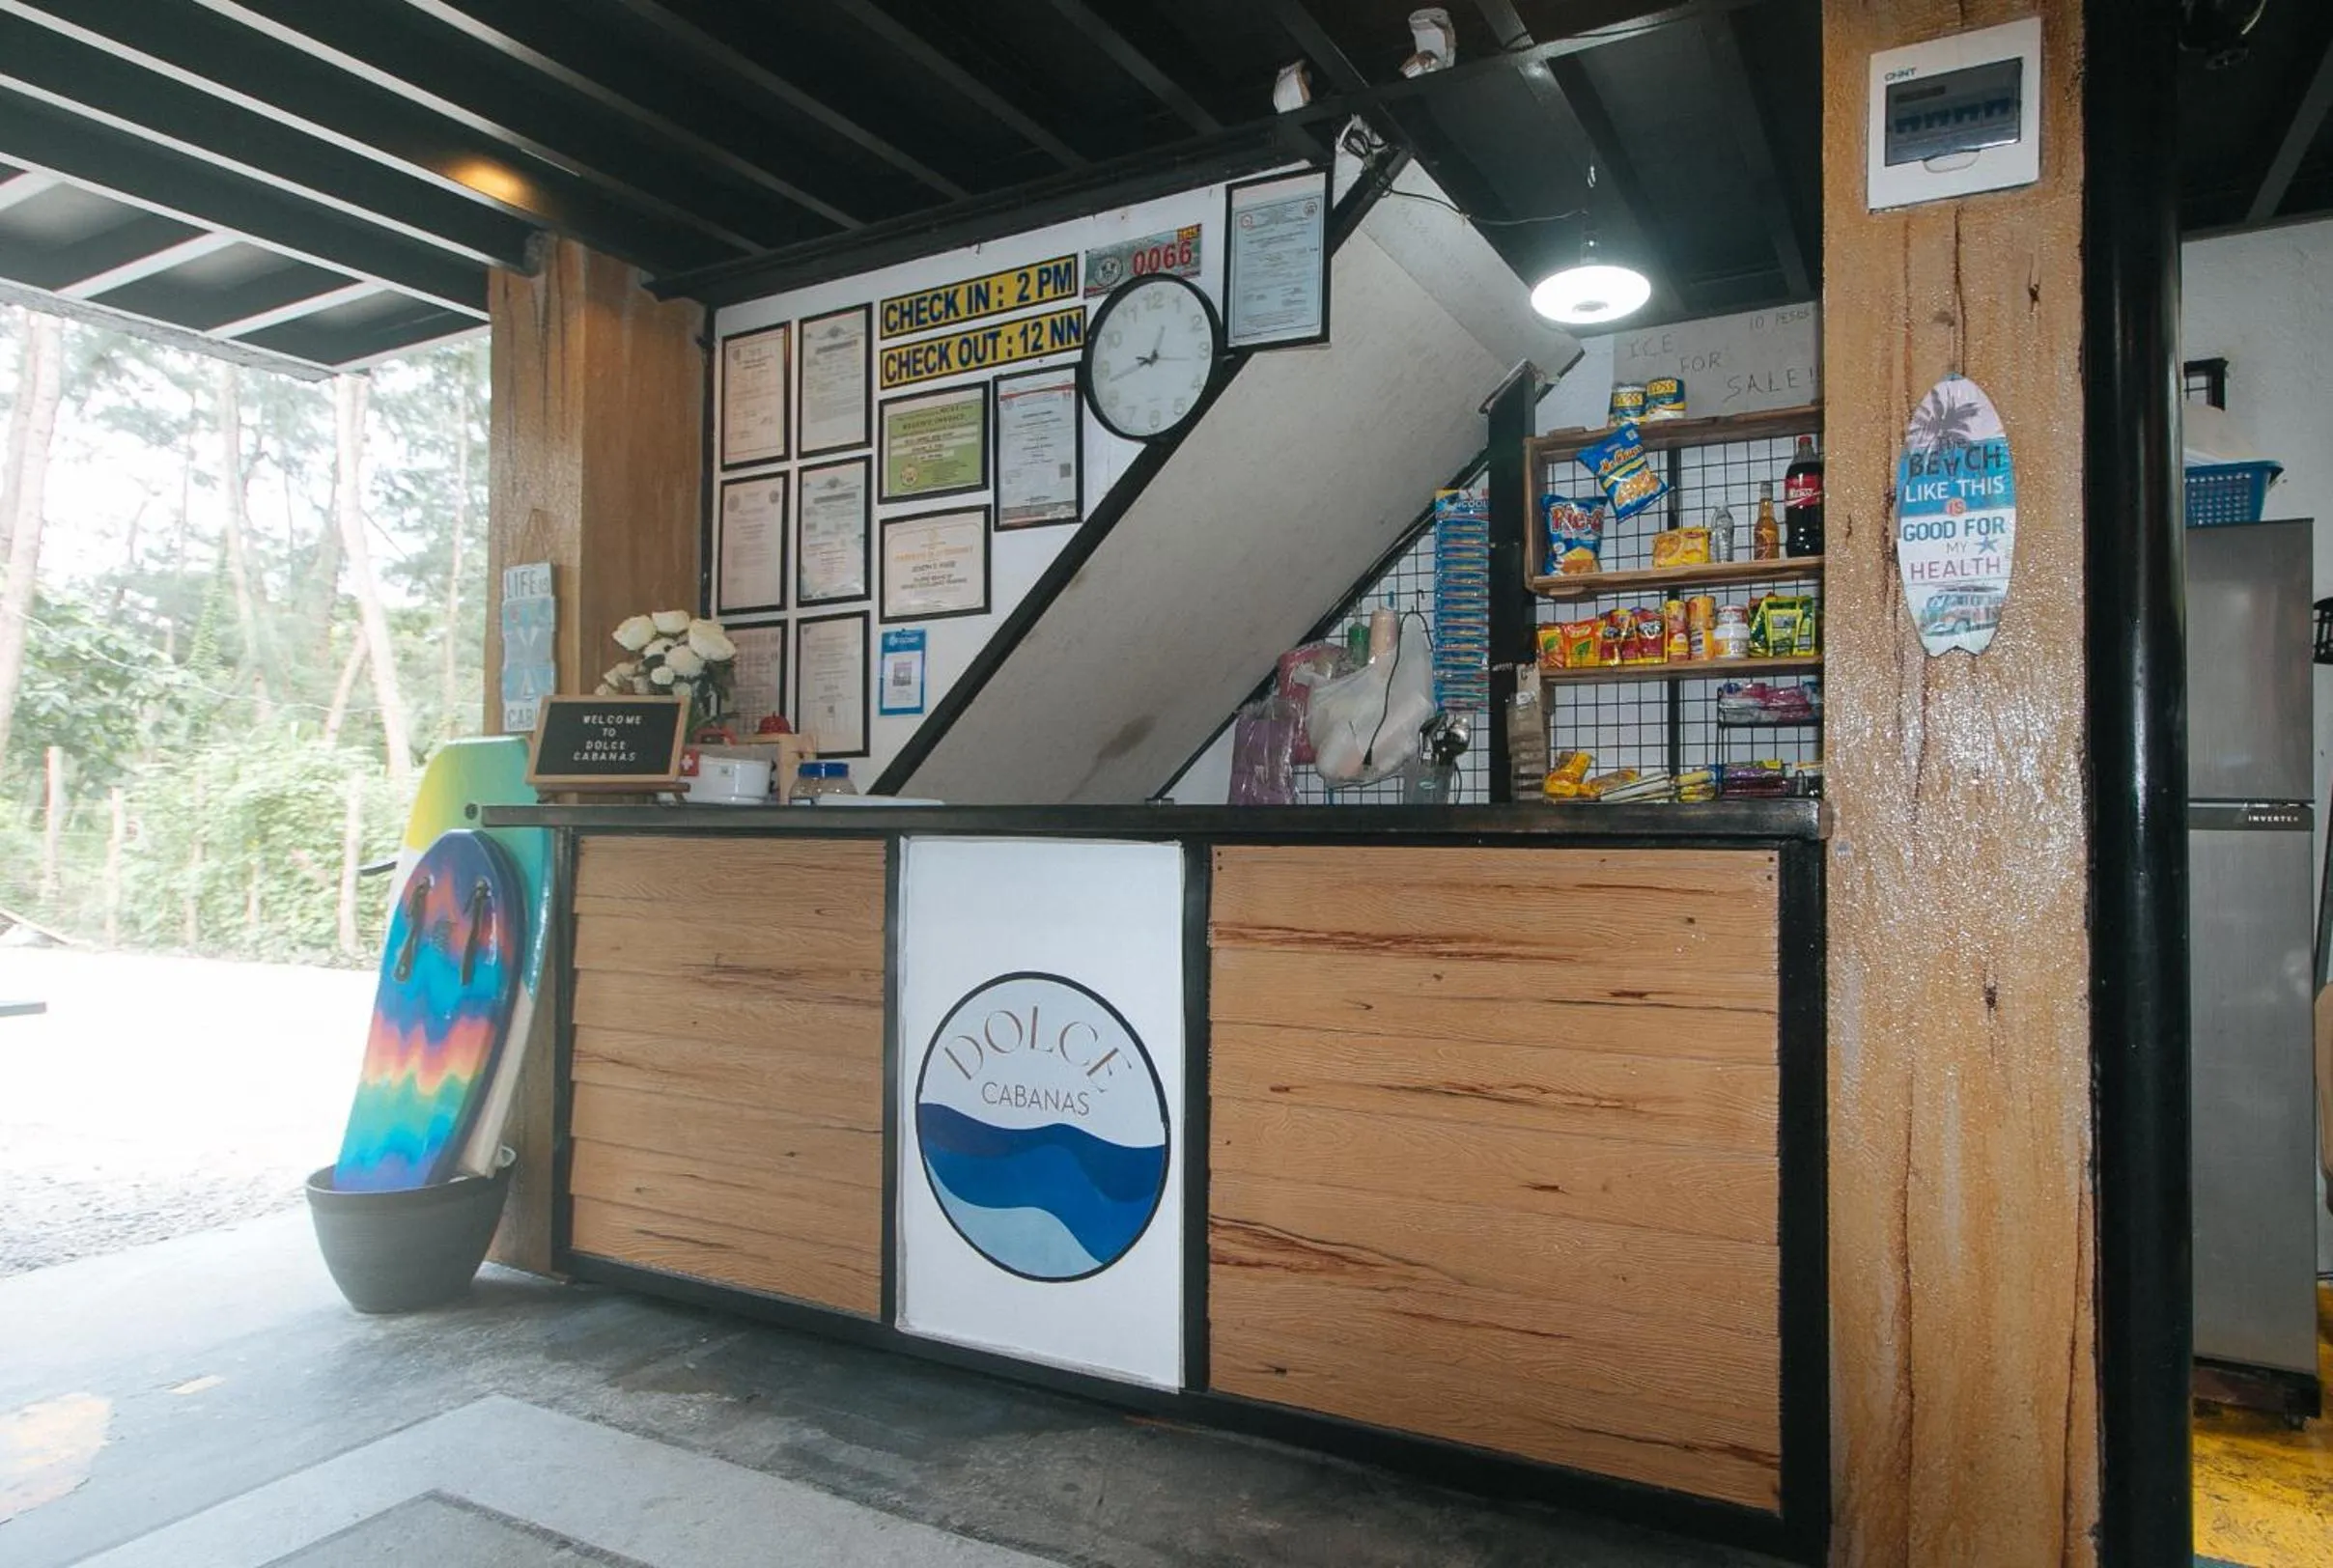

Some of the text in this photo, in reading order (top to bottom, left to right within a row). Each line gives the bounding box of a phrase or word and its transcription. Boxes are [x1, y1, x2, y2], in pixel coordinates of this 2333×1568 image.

[1132, 239, 1193, 276] 0066
[884, 289, 961, 332] CHECK
[1017, 272, 1030, 303] 2
[1037, 261, 1073, 298] PM
[1142, 291, 1164, 311] 12
[1190, 315, 1205, 332] 2
[884, 341, 952, 383] CHECK
[1020, 322, 1044, 354] 12
[1050, 312, 1082, 348] NN
[1629, 333, 1673, 359] ICE
[1679, 351, 1722, 374] FOR
[1905, 476, 2006, 502] LIKE THIS
[1902, 517, 2006, 542] GOOD FOR
[1947, 542, 1967, 553] MY
[1910, 556, 2002, 580] HEALTH
[506, 570, 536, 599] LIFE
[582, 714, 642, 724] WELCOME
[602, 727, 617, 737] TO
[573, 751, 636, 762] CABANAS
[585, 740, 627, 750] DOLCE
[944, 1005, 1132, 1093] DOLCE
[981, 1081, 1090, 1117] CABANAS
